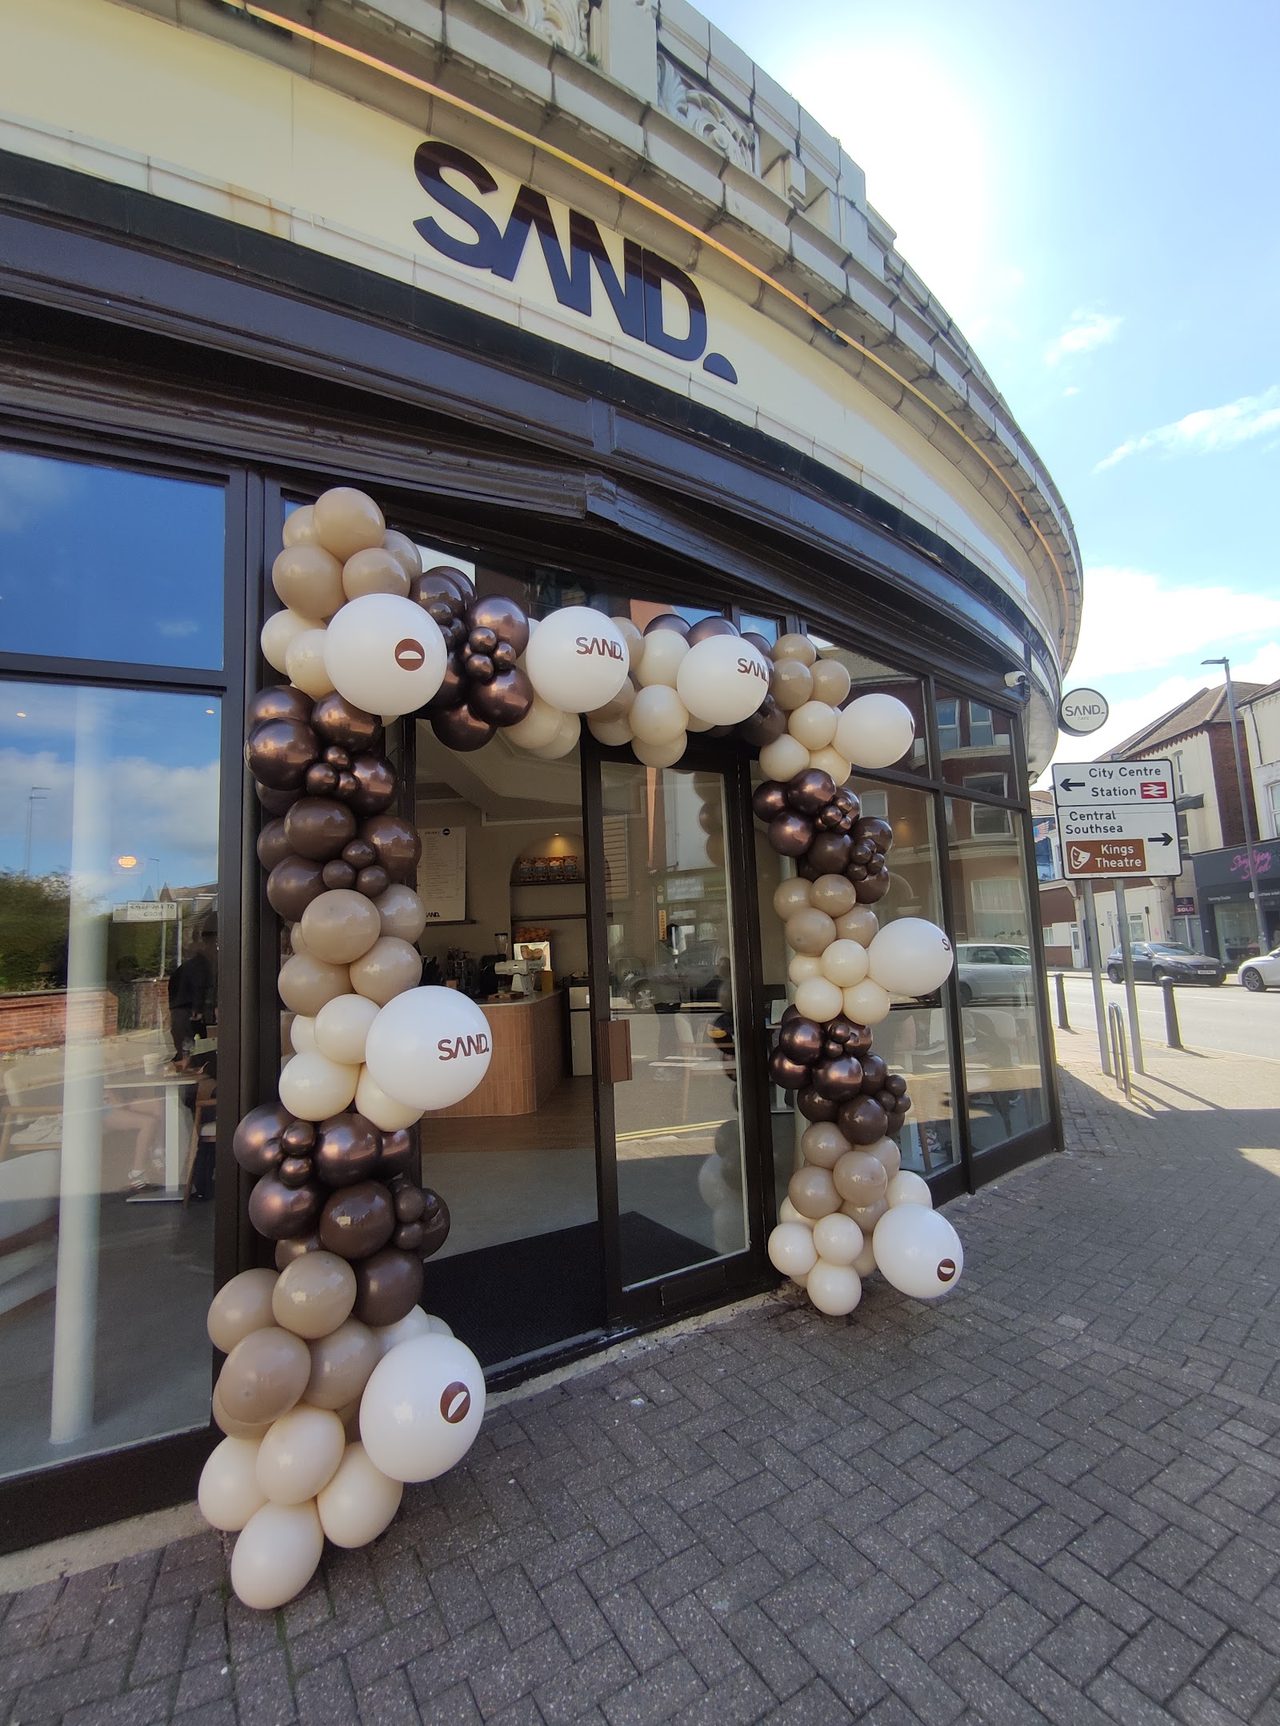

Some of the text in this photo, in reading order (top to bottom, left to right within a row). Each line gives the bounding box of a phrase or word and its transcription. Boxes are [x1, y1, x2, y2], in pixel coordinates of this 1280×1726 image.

[1088, 766, 1161, 780] City Centre
[1091, 786, 1137, 797] Station
[1069, 810, 1117, 821] Central
[1065, 824, 1124, 835] Southsea
[1100, 843, 1135, 856] Kings
[1095, 857, 1142, 868] Theatre
